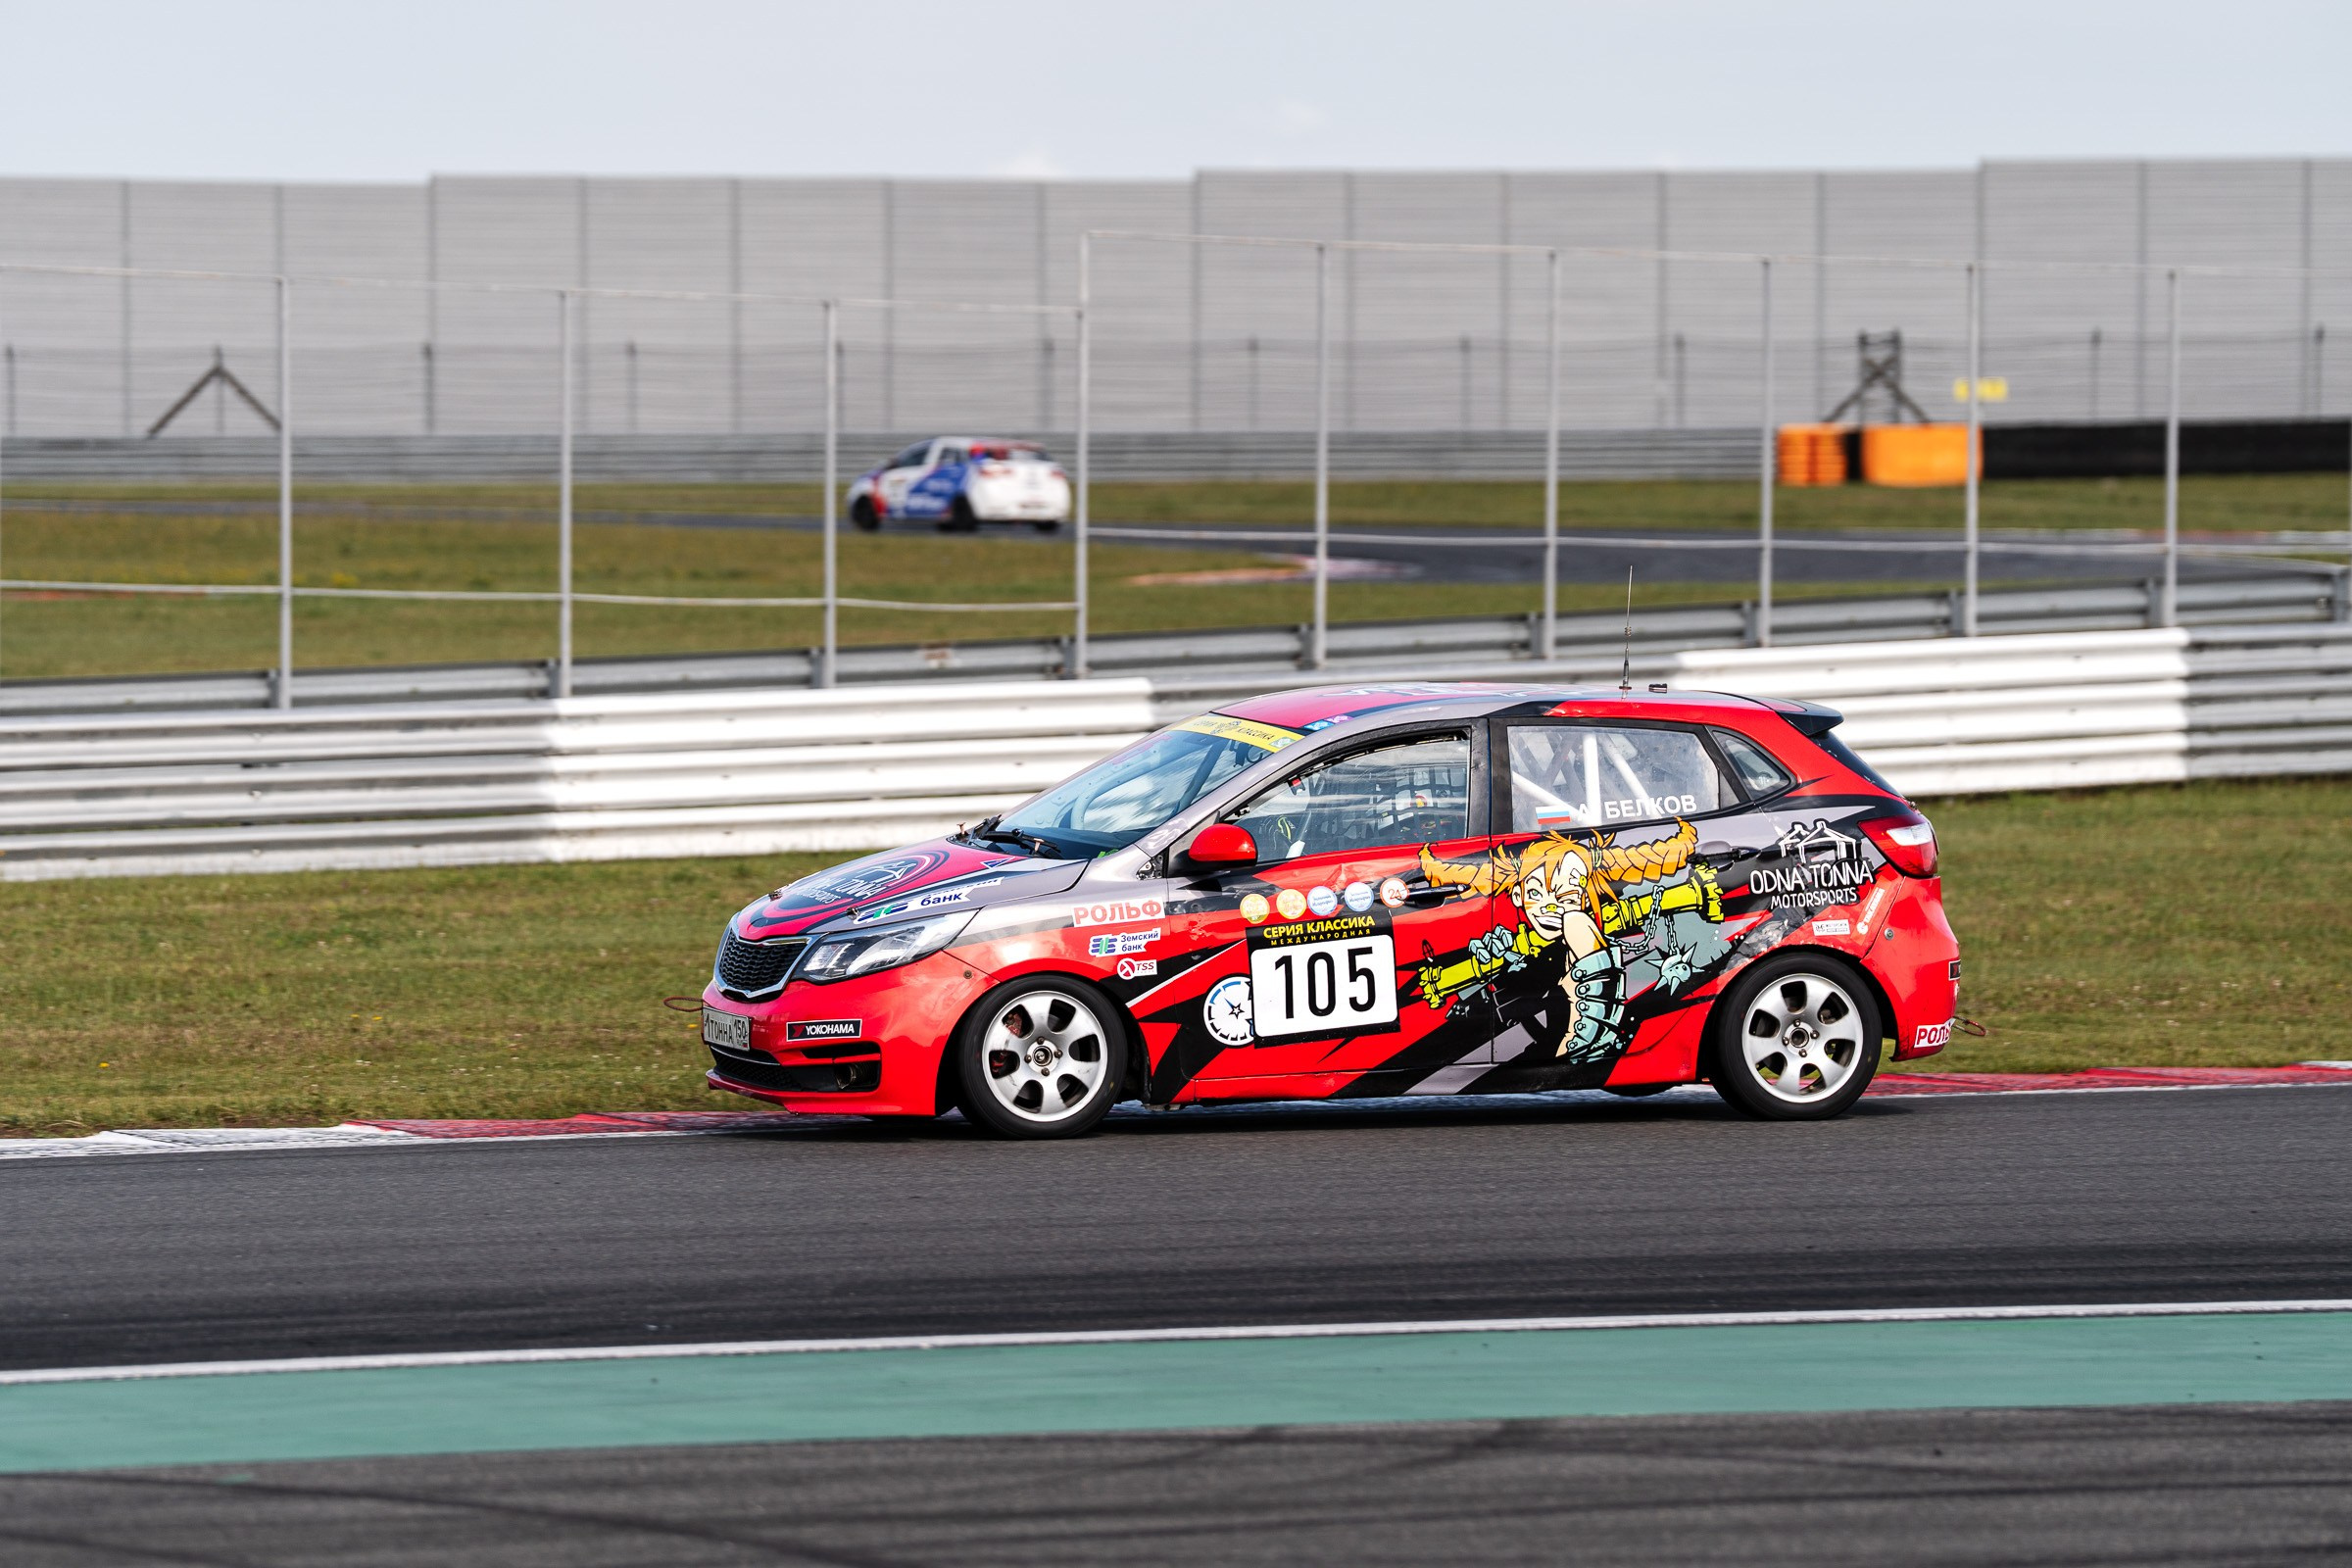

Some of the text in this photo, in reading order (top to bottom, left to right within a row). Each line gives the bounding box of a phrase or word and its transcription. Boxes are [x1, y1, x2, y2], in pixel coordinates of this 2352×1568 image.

[1604, 794, 1697, 819] БЕЛКОВ
[1750, 859, 1874, 895] ODNA TONNA
[920, 891, 963, 906] банк
[1770, 887, 1858, 909] MOTORSPORTS
[1073, 900, 1161, 924] РОЛЬФ
[1120, 930, 1159, 943] Земский
[1263, 915, 1376, 939] СЕРИЯ КЛАССИКА
[1270, 928, 1372, 946] МЕЖДУНАРОДНАЯ
[1121, 943, 1144, 952] банк
[1136, 961, 1154, 971] TSS
[1275, 946, 1377, 1019] 105
[805, 1024, 855, 1036] YOKOHAMA
